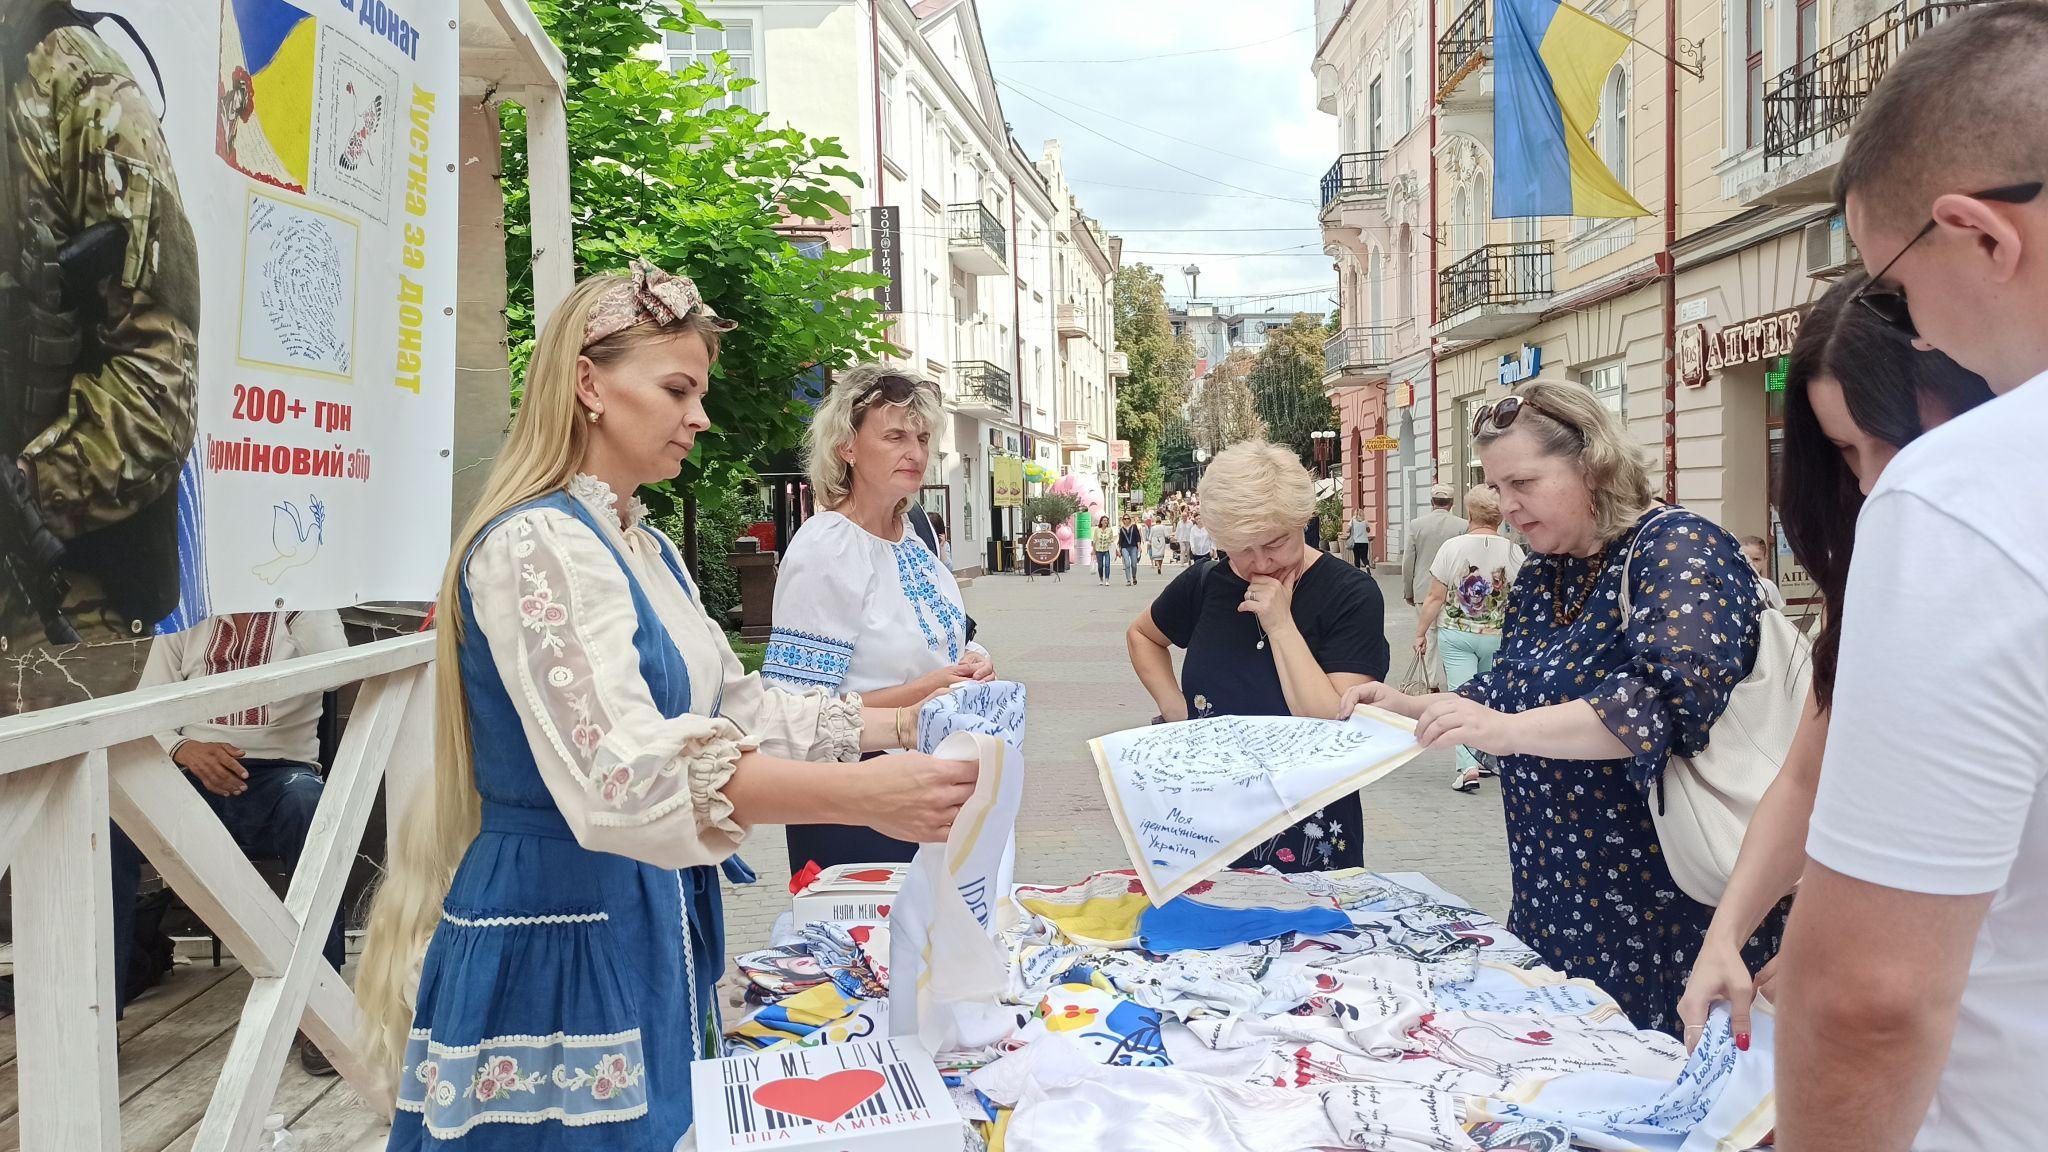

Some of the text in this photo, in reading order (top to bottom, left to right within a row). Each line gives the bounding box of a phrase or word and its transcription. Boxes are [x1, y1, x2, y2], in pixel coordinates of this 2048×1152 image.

[394, 82, 436, 395] Хустка за донат
[1705, 310, 1801, 372] АПТЕК
[232, 383, 352, 433] 200+ грн
[206, 433, 371, 483] Терміновий збір
[1781, 571, 1809, 582] АПТ
[1166, 806, 1193, 825] Моя
[1148, 834, 1196, 859] Україна
[721, 1038, 905, 1084] BUY ME LOVE
